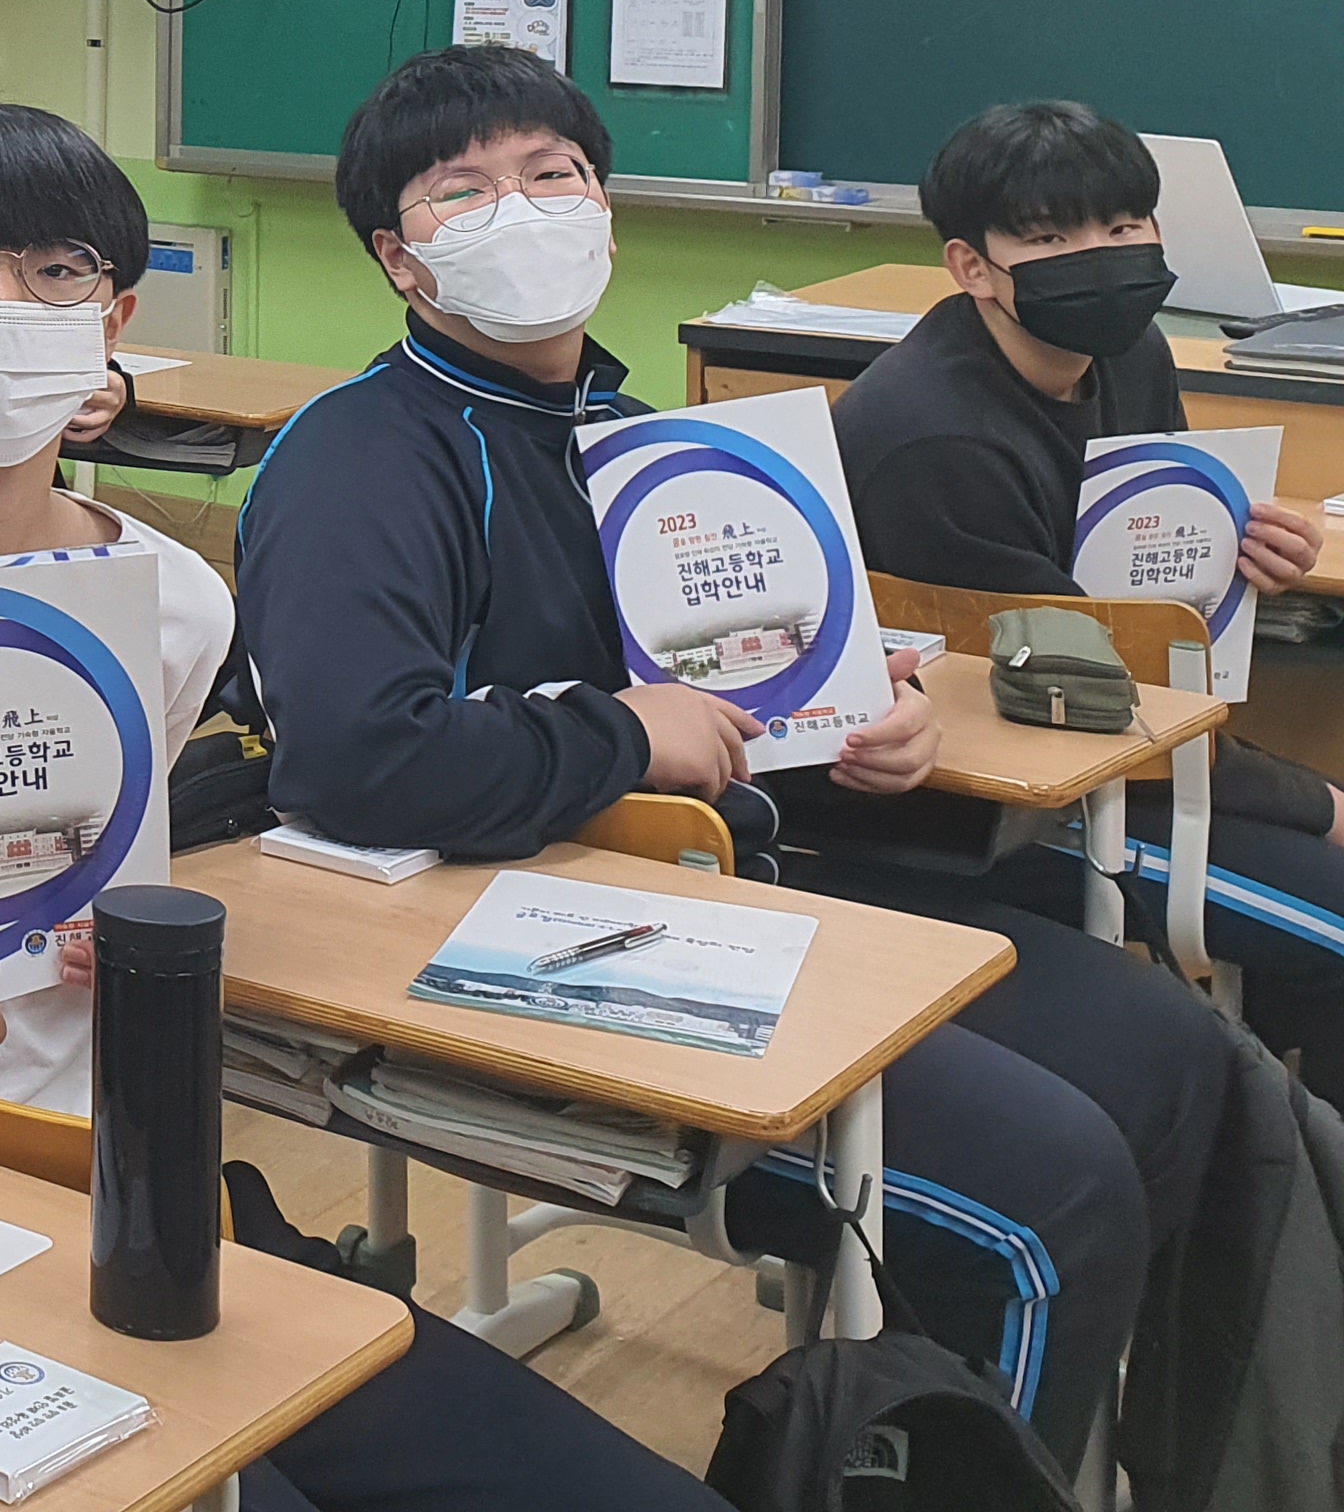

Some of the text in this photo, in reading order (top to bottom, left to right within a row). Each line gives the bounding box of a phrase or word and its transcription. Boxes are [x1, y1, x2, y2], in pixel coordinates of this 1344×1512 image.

[658, 513, 697, 535] 2023
[1127, 515, 1160, 530] 2023
[677, 548, 784, 582] 진해고등학교
[1132, 546, 1211, 567] 진해고등학교
[1129, 564, 1194, 586] 입학안내
[682, 572, 766, 606] 입학안내
